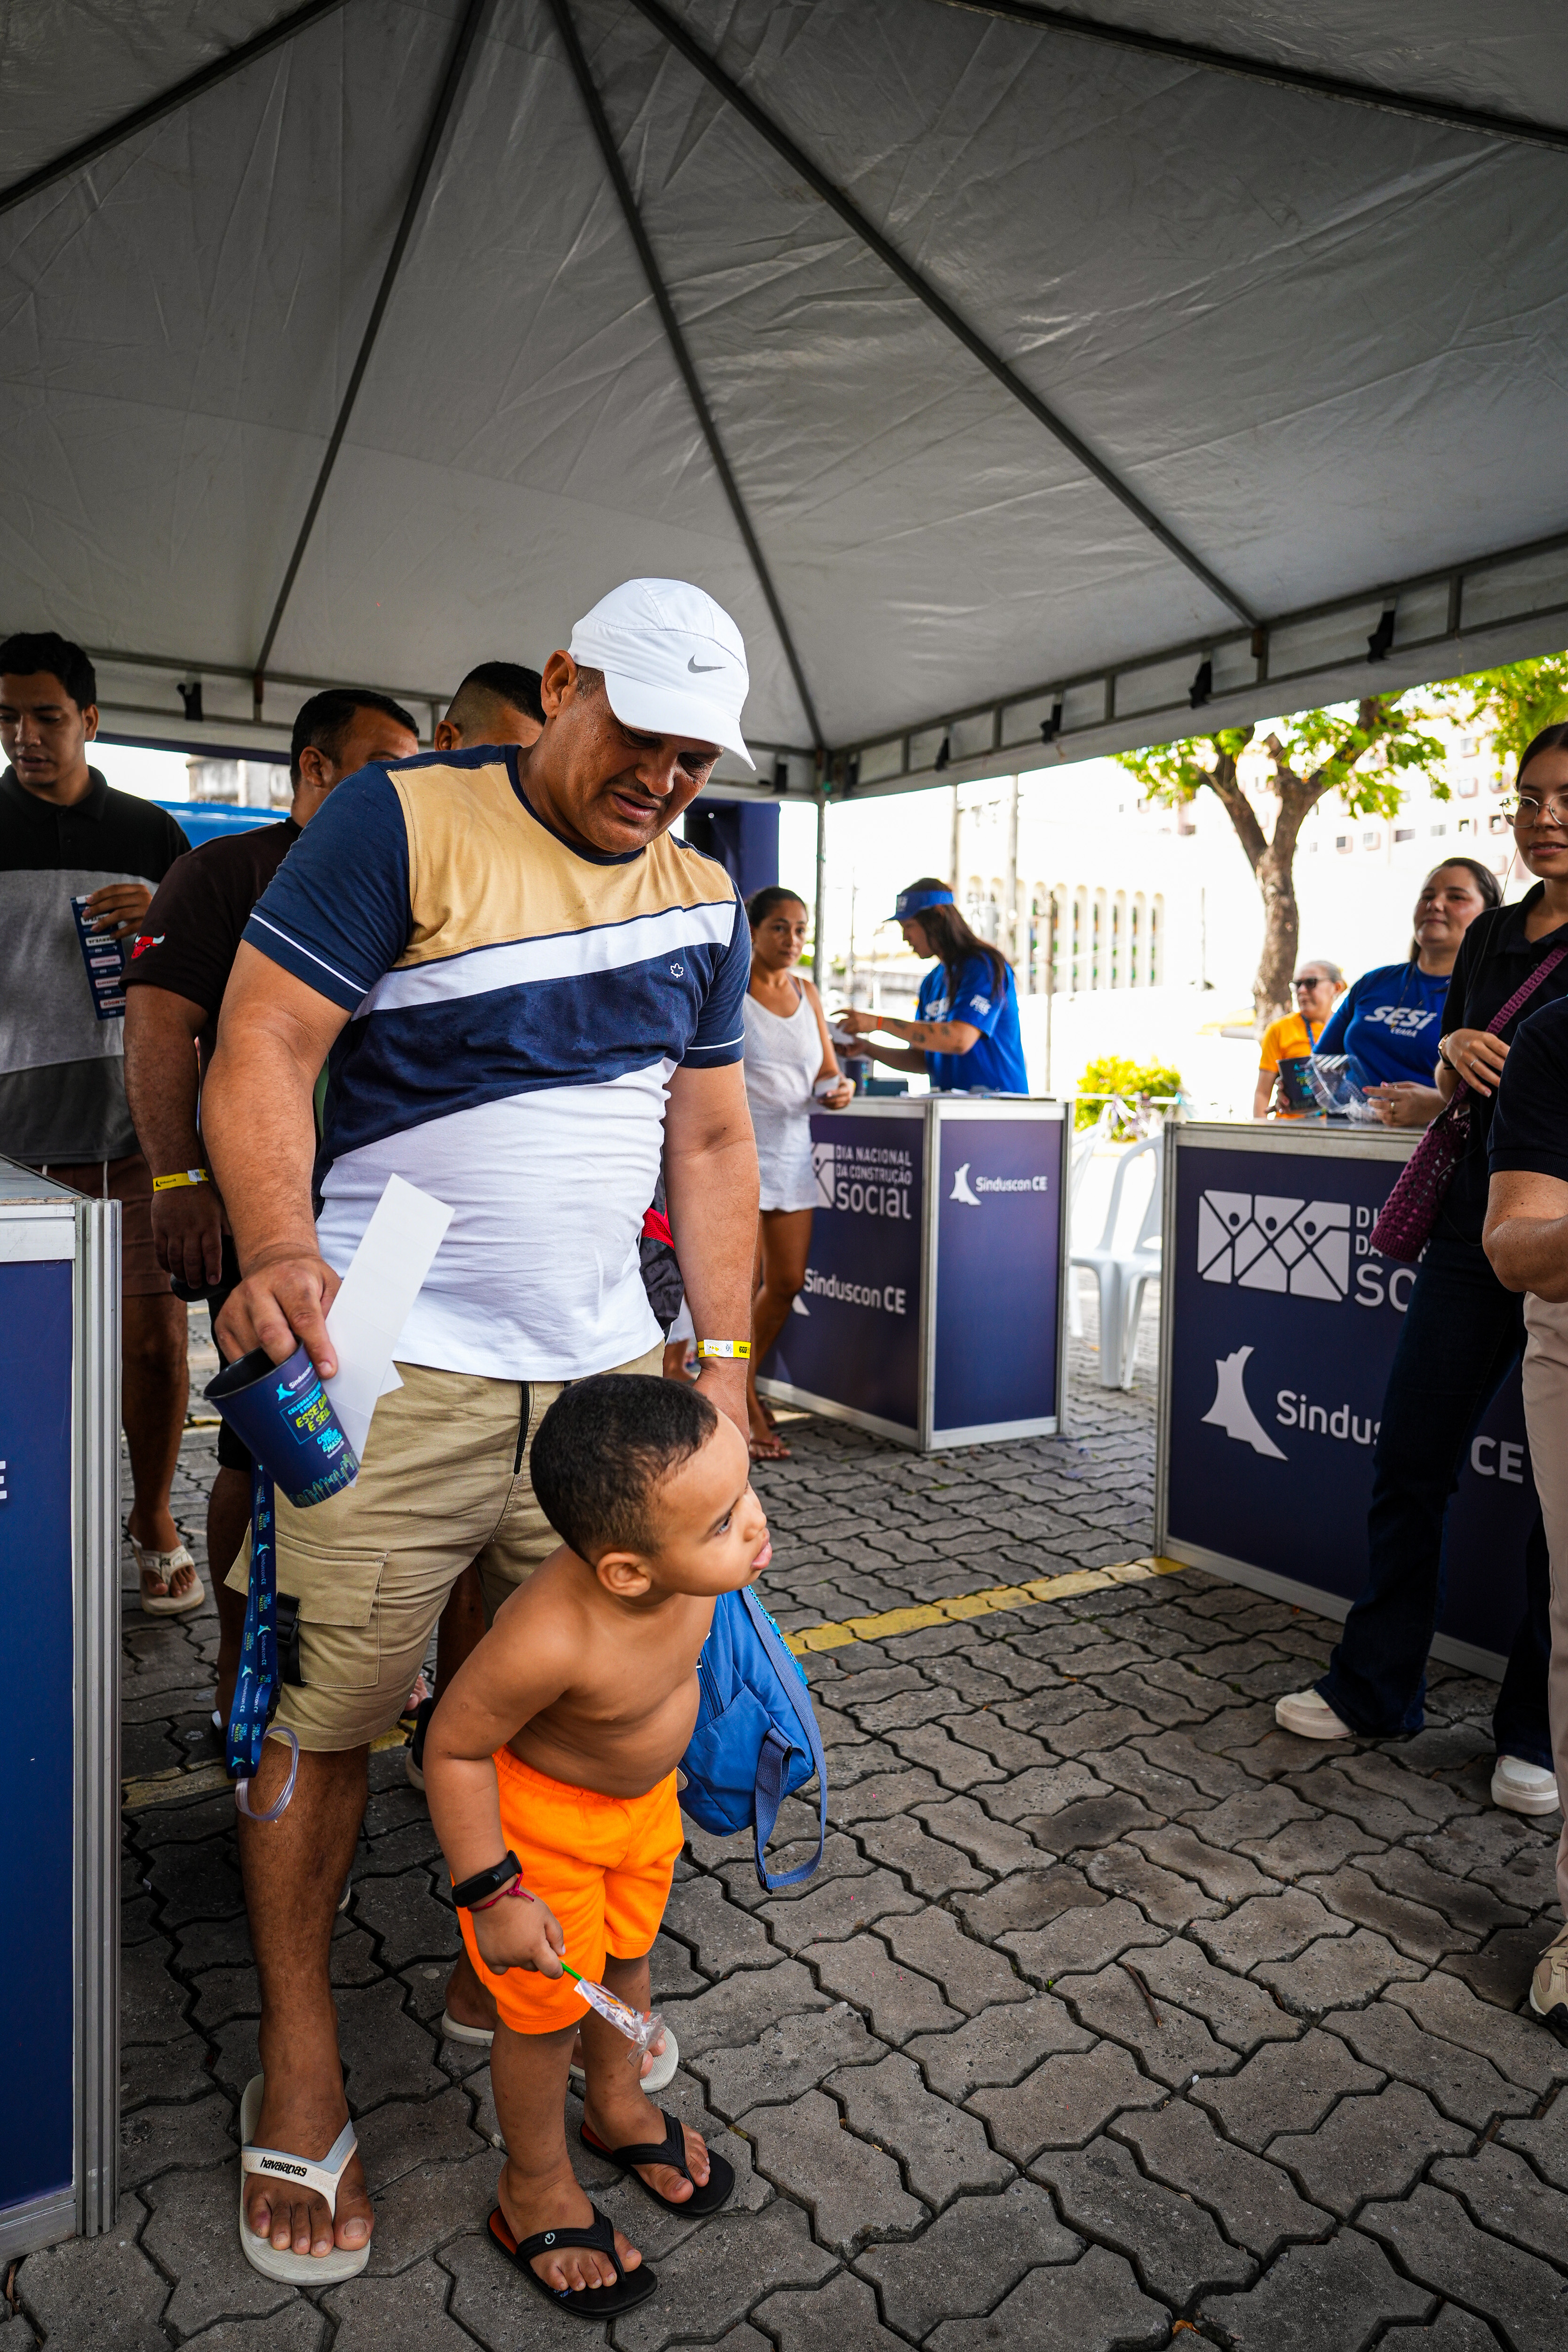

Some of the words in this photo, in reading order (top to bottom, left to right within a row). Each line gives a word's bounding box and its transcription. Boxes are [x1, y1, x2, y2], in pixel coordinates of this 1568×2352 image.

[836, 1144, 854, 1161] DIA
[856, 1146, 913, 1167] NACIONAL
[836, 1163, 848, 1178] DA
[849, 1164, 913, 1186] CONSTRUÇÃO
[976, 1176, 1032, 1192] Sinduscon
[1032, 1176, 1048, 1192] CE
[1356, 1206, 1379, 1229] DI
[804, 1268, 881, 1309] Sinduscon
[883, 1285, 907, 1315] CE
[1354, 1263, 1417, 1312] SO
[295, 1404, 319, 1428] ESSE
[1276, 1390, 1381, 1446] Sindu
[1471, 1435, 1524, 1484] CE
[260, 2157, 307, 2177] havaianas
